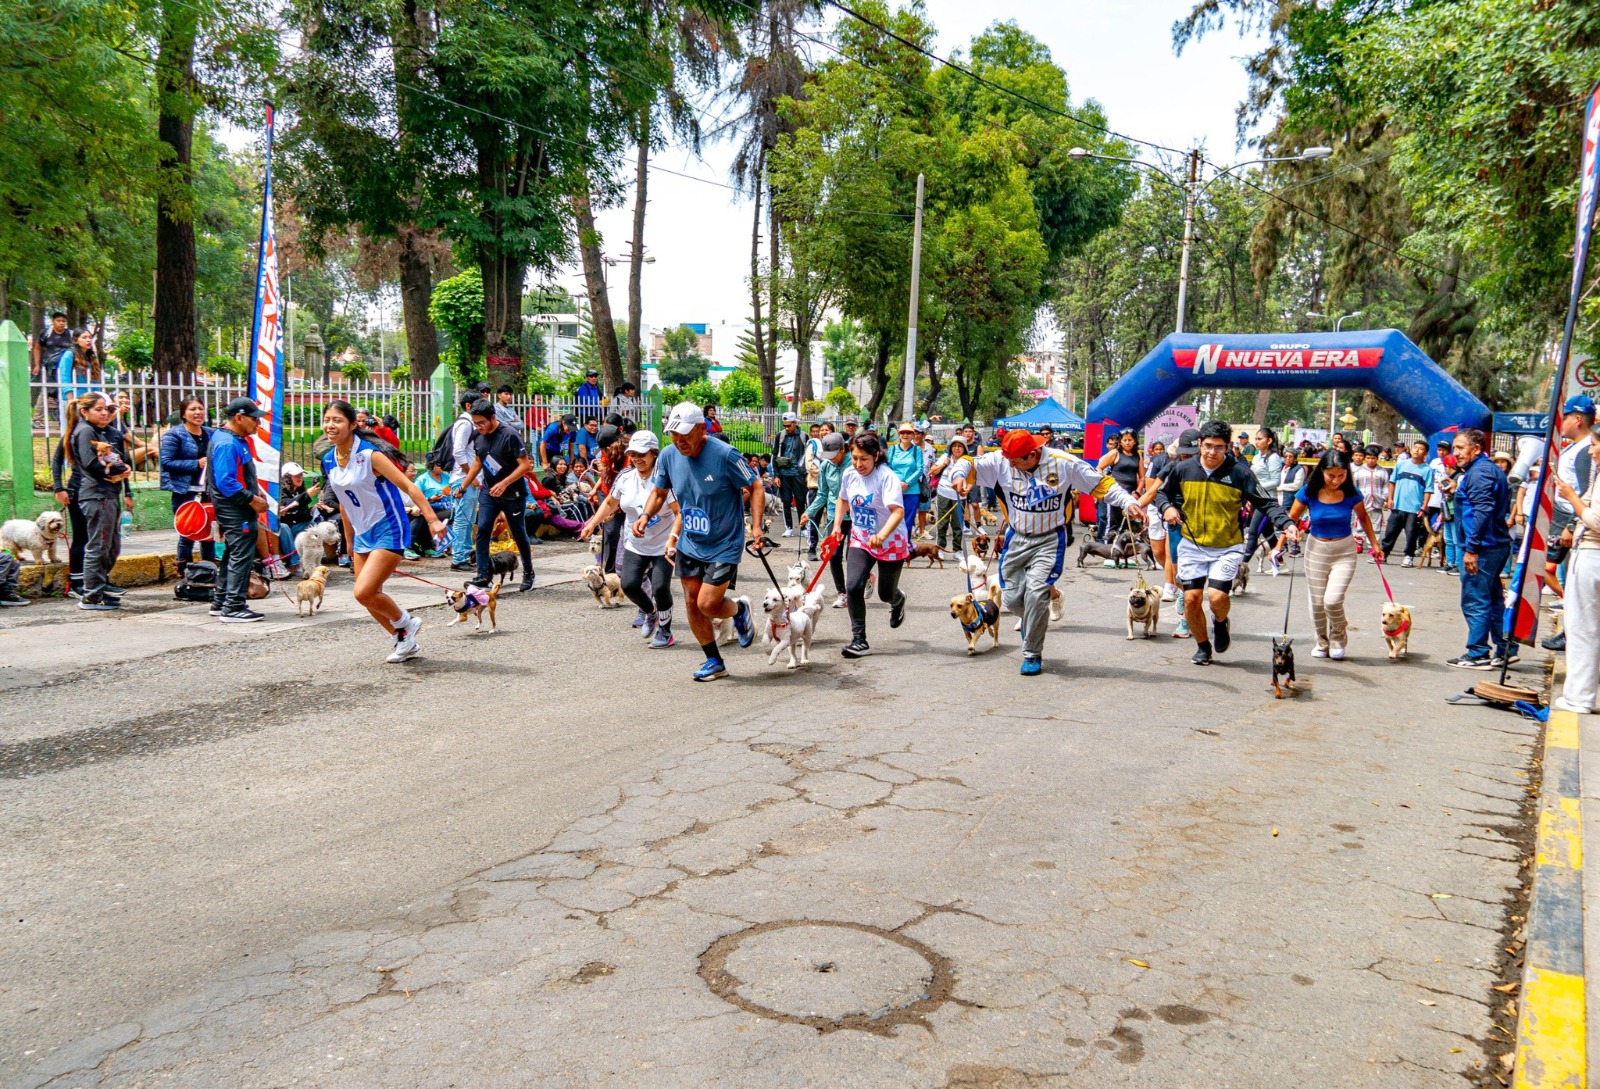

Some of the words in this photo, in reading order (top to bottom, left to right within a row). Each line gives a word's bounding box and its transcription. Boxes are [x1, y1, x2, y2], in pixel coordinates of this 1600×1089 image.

[1225, 350, 1304, 368] NUEVA
[1309, 350, 1360, 367] ERA
[1051, 422, 1082, 430] MUNICIPAL
[1036, 496, 1060, 511] LUIS
[685, 514, 709, 532] 300
[855, 512, 876, 527] 275
